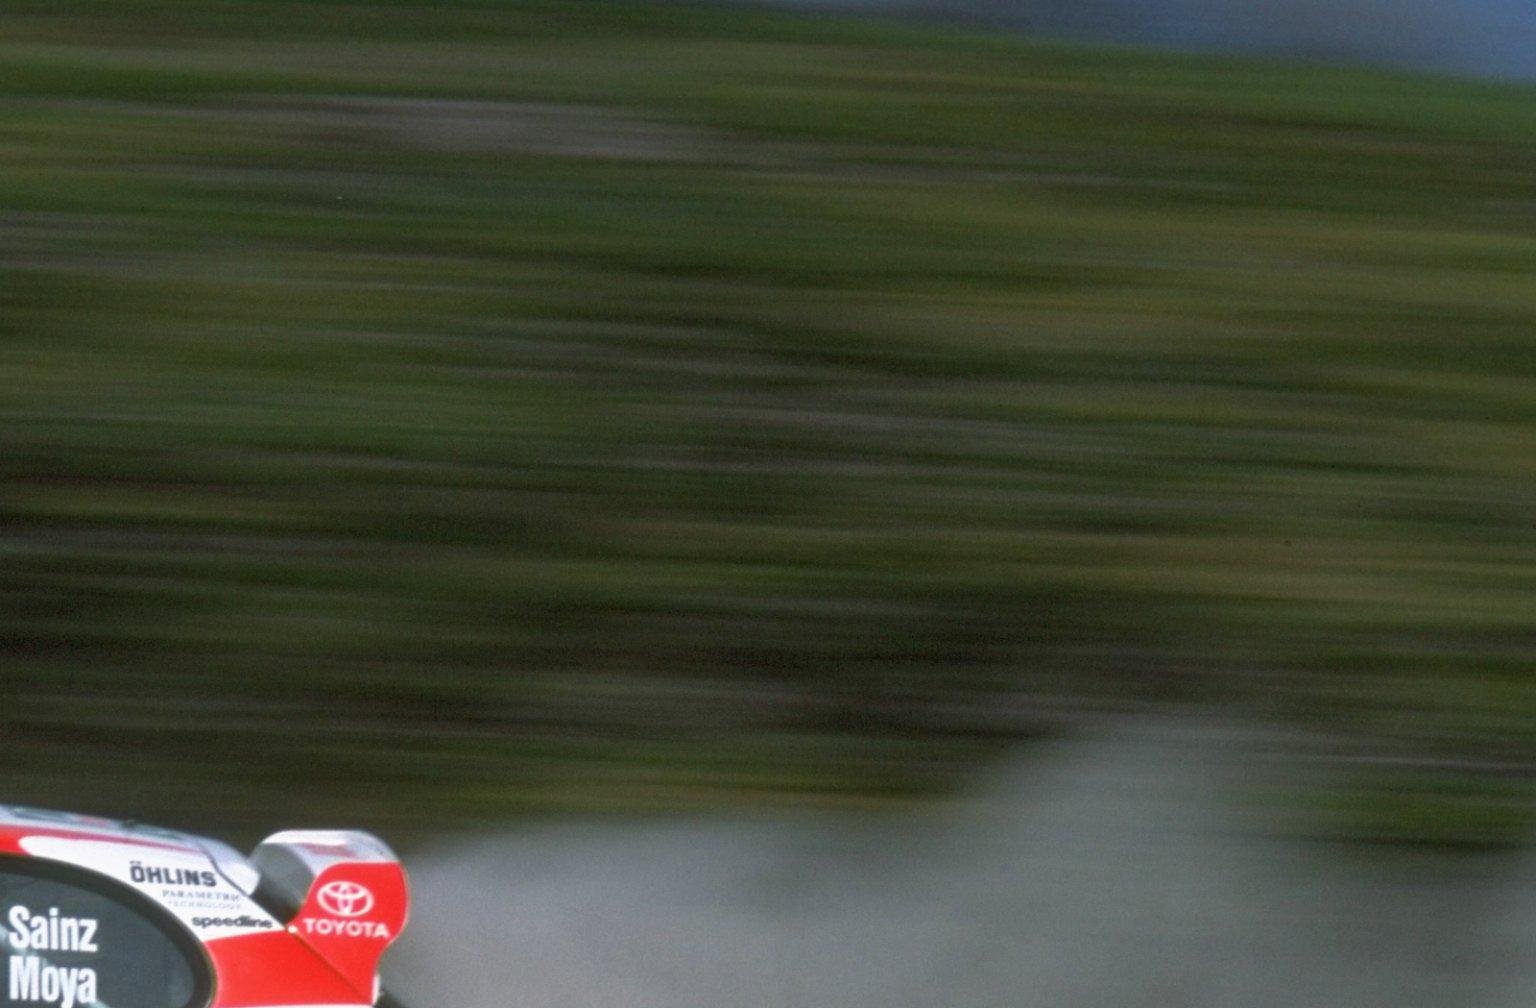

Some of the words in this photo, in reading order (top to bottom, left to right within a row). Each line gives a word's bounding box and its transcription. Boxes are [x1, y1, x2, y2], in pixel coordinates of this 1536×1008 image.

[129, 860, 217, 887] ÖHLINS
[9, 905, 98, 952] Sainz
[192, 915, 273, 929] speedline
[303, 918, 390, 938] TOYOTA
